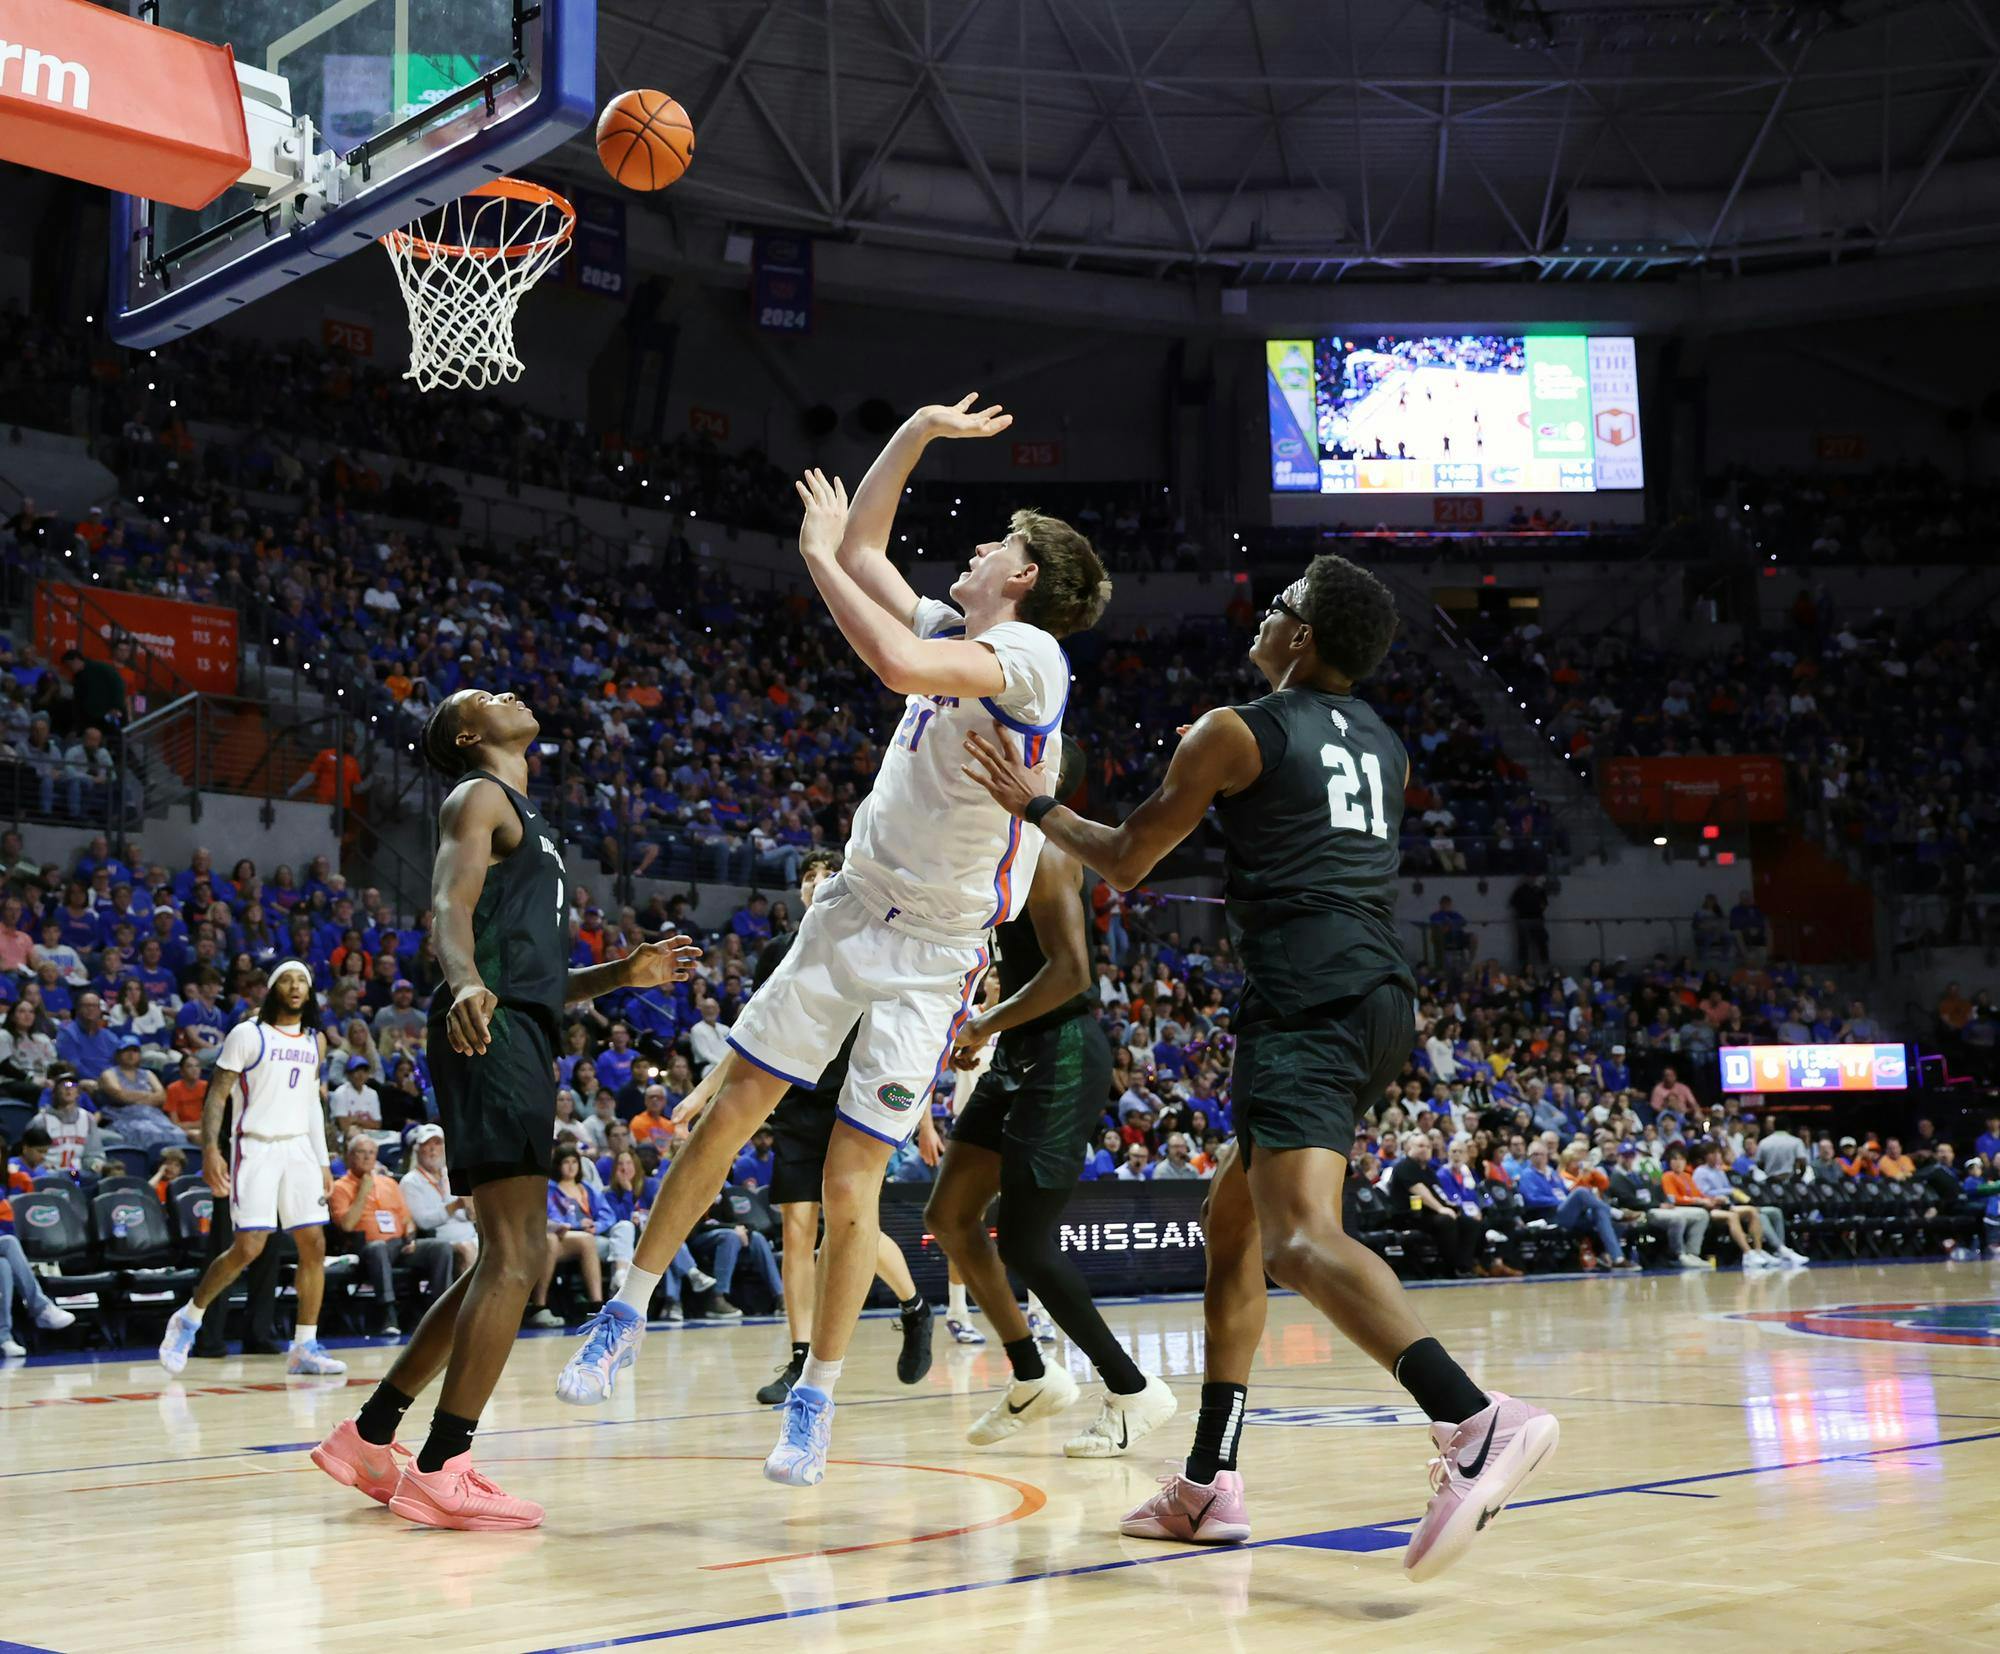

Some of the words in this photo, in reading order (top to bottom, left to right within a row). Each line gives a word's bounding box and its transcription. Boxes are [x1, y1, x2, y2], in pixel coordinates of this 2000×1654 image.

[582, 265, 622, 292] 2023
[760, 307, 806, 329] 2024
[330, 324, 367, 352] 213
[1017, 444, 1053, 464] 215
[1439, 500, 1478, 520] 216
[896, 702, 936, 753] 21
[1320, 743, 1388, 840] 21
[884, 906, 901, 923] F
[270, 1047, 316, 1065] FLORIDA
[288, 1067, 300, 1089] 0
[1726, 1055, 1749, 1083] D
[1060, 1221, 1206, 1252] NISSAN
